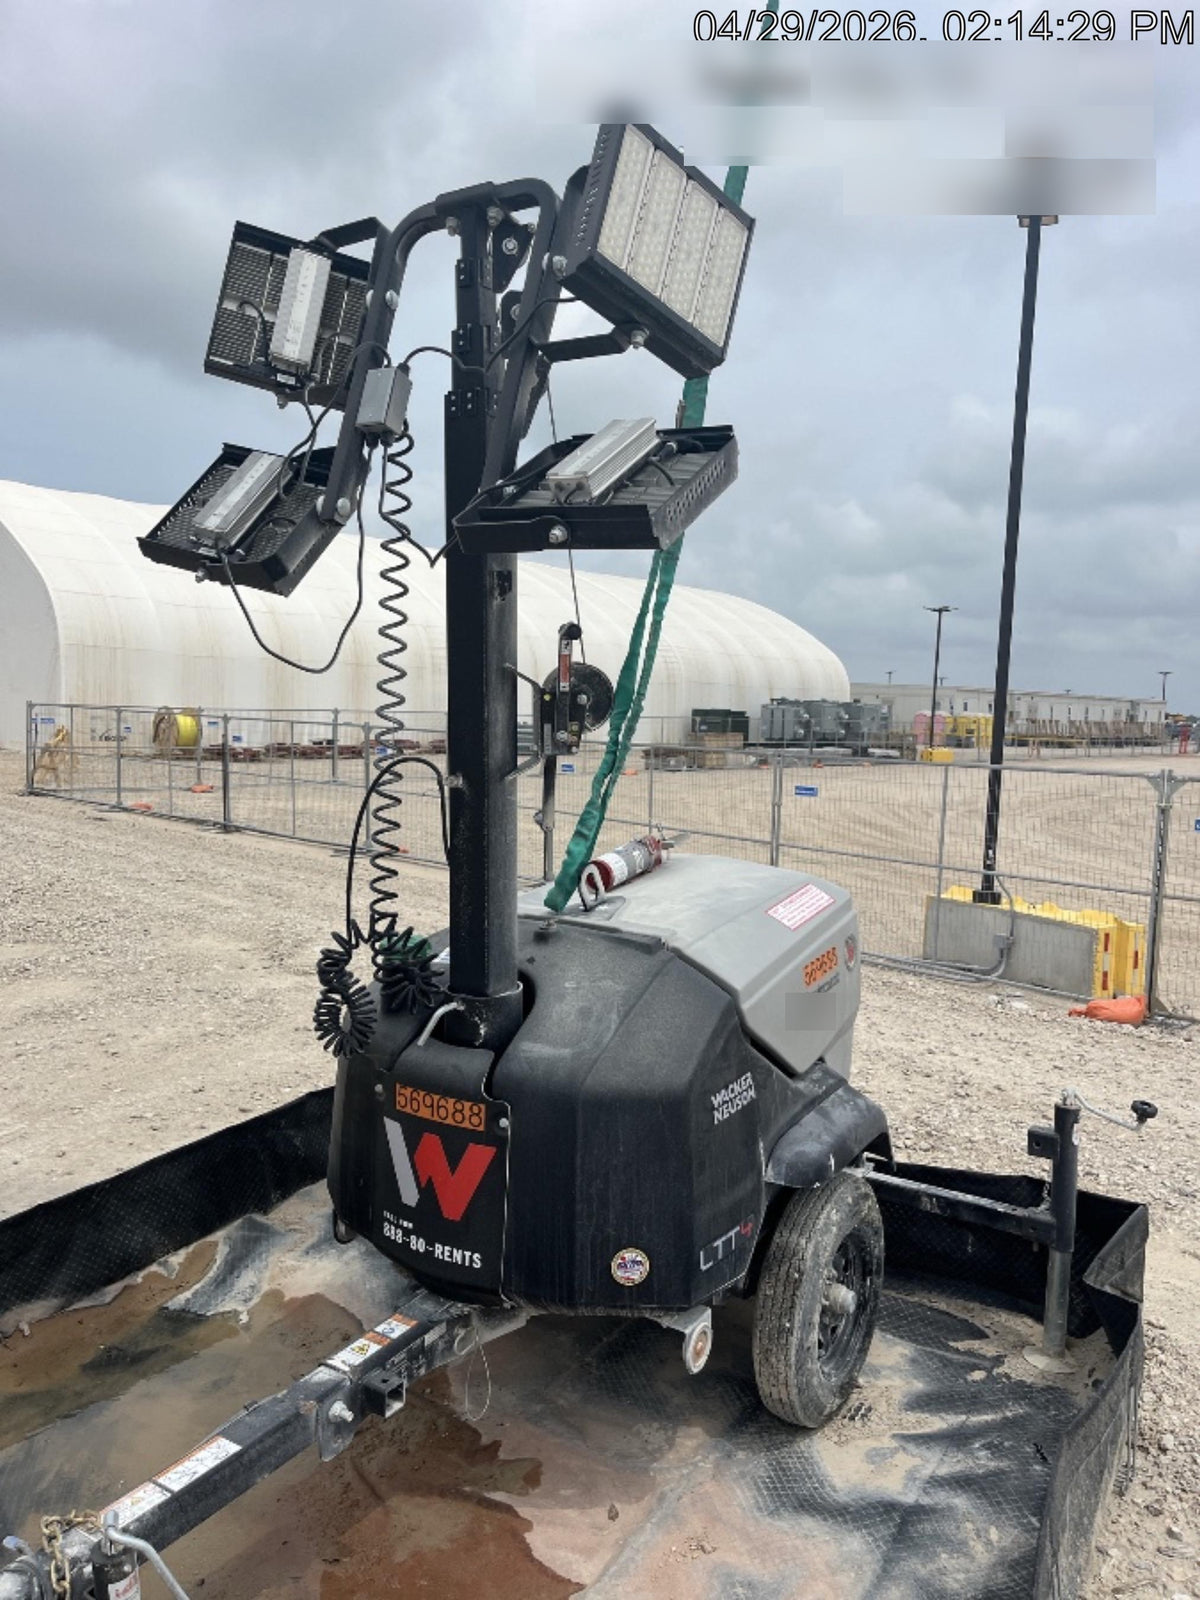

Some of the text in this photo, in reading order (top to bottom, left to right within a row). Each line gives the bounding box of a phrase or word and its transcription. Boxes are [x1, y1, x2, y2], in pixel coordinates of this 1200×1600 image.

[397, 1085, 482, 1128] 569688
[711, 1071, 753, 1108] WACKER
[713, 1083, 756, 1125] NEUSON
